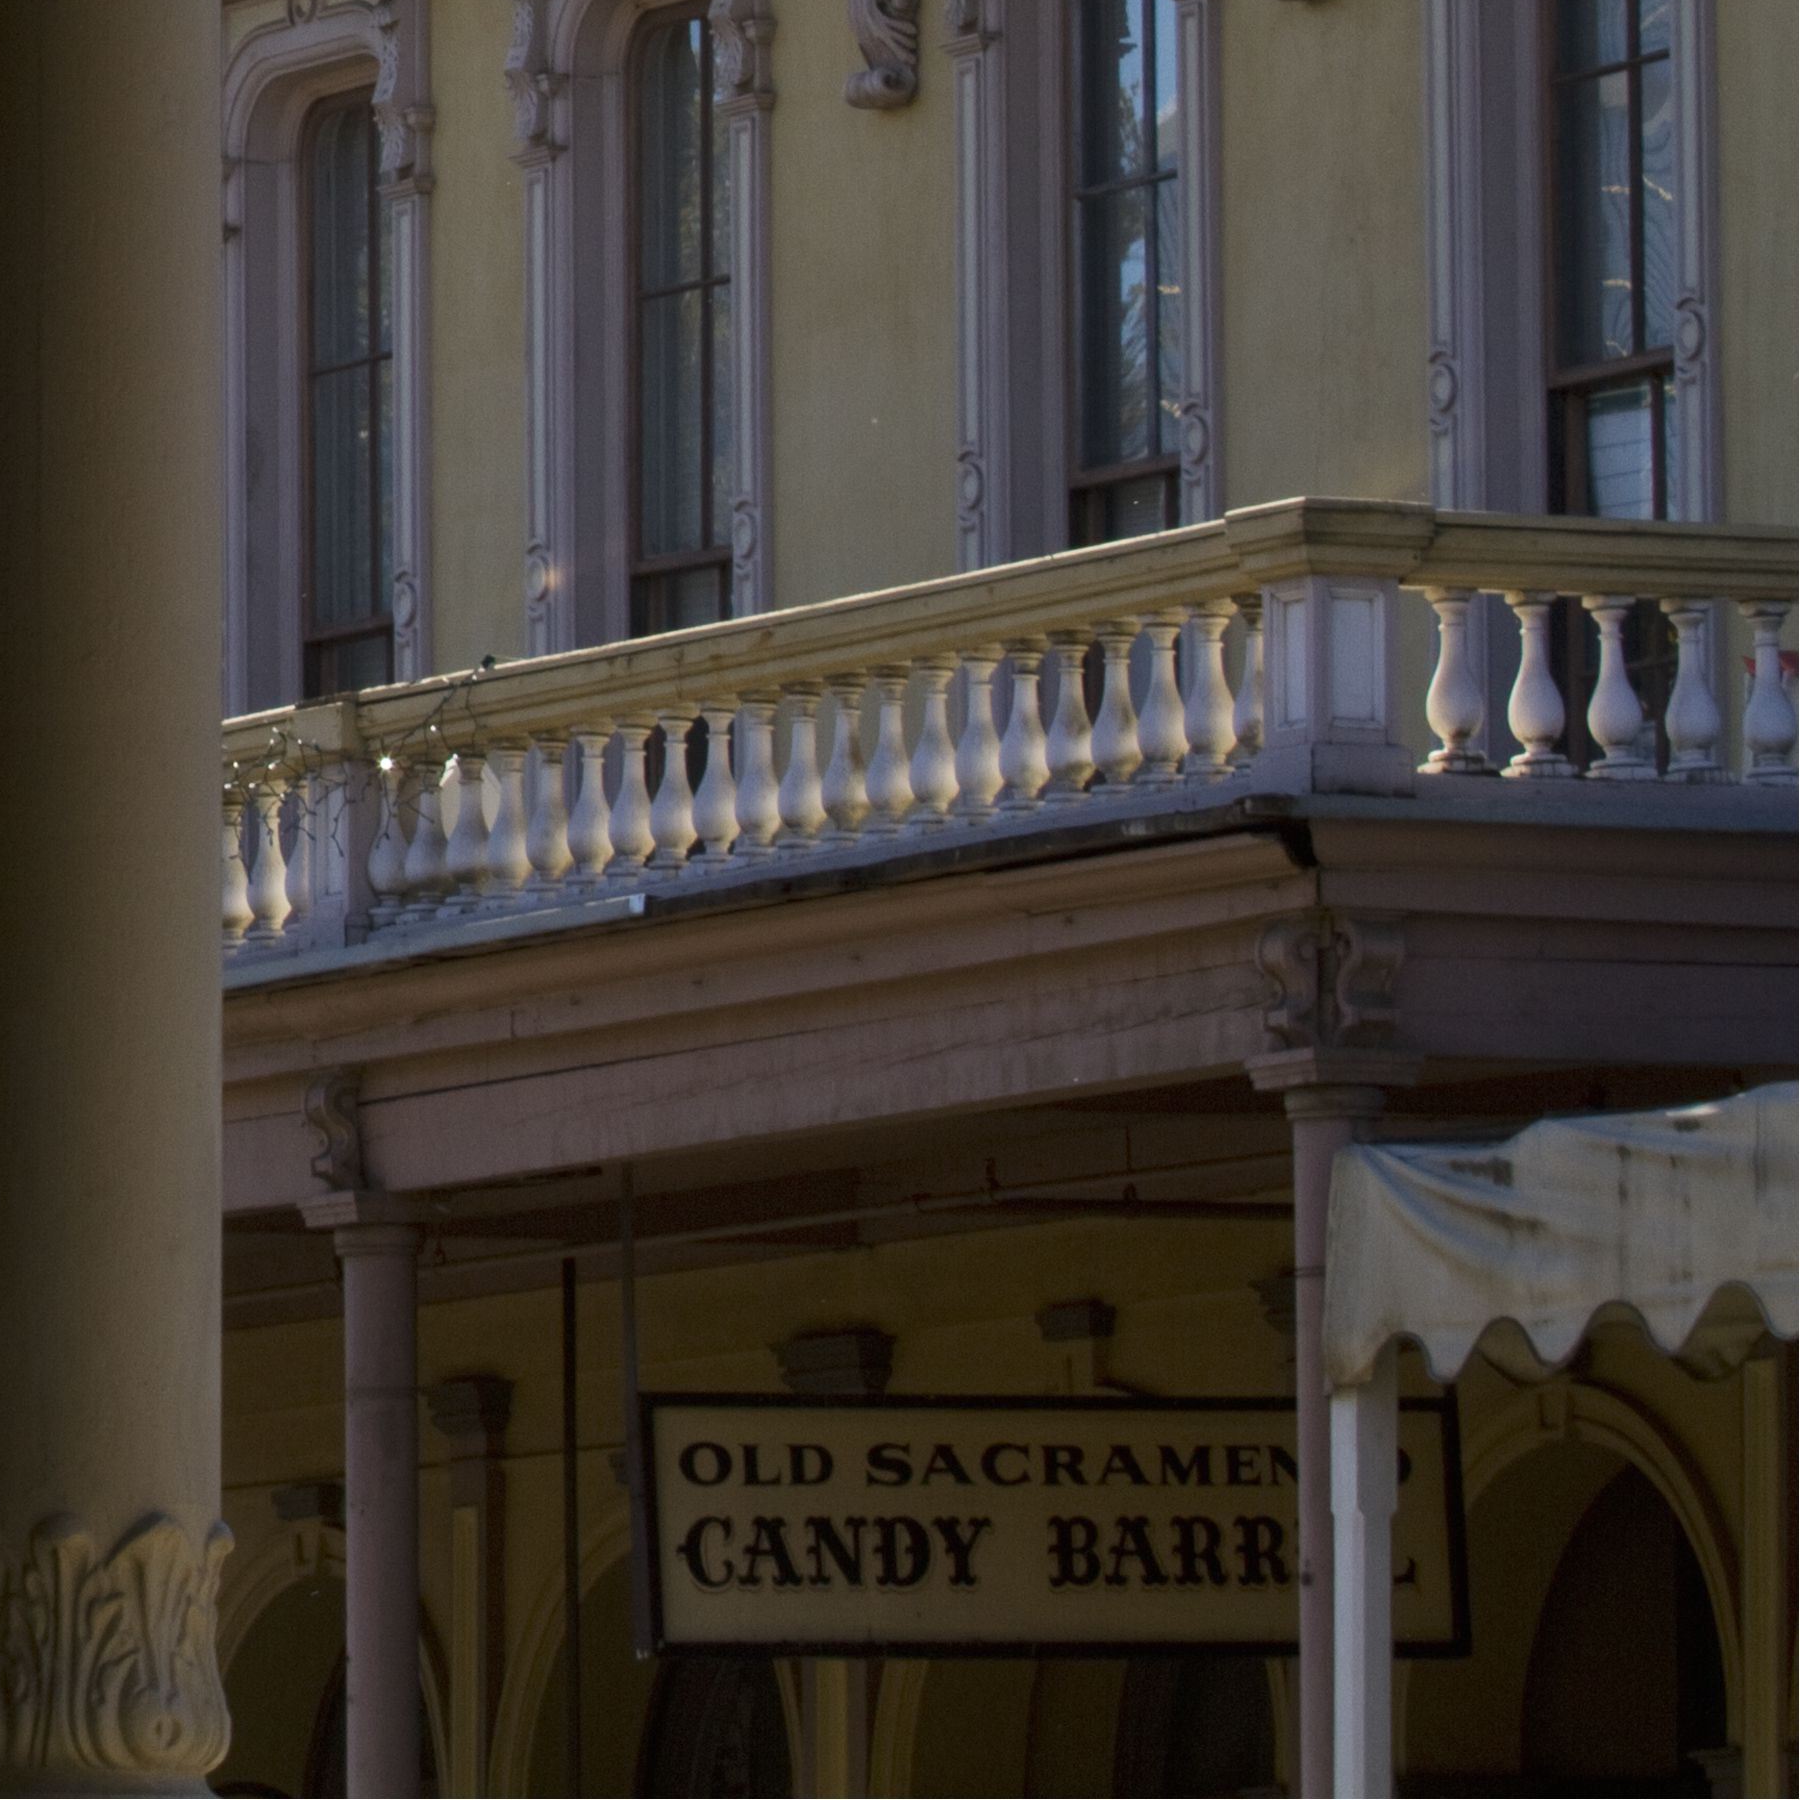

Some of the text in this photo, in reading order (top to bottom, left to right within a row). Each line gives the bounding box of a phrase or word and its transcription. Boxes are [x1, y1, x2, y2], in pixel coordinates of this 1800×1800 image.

[679, 1441, 1412, 1488] OLD SACRAMEN
[676, 1514, 1417, 1589] CANDY BARR
